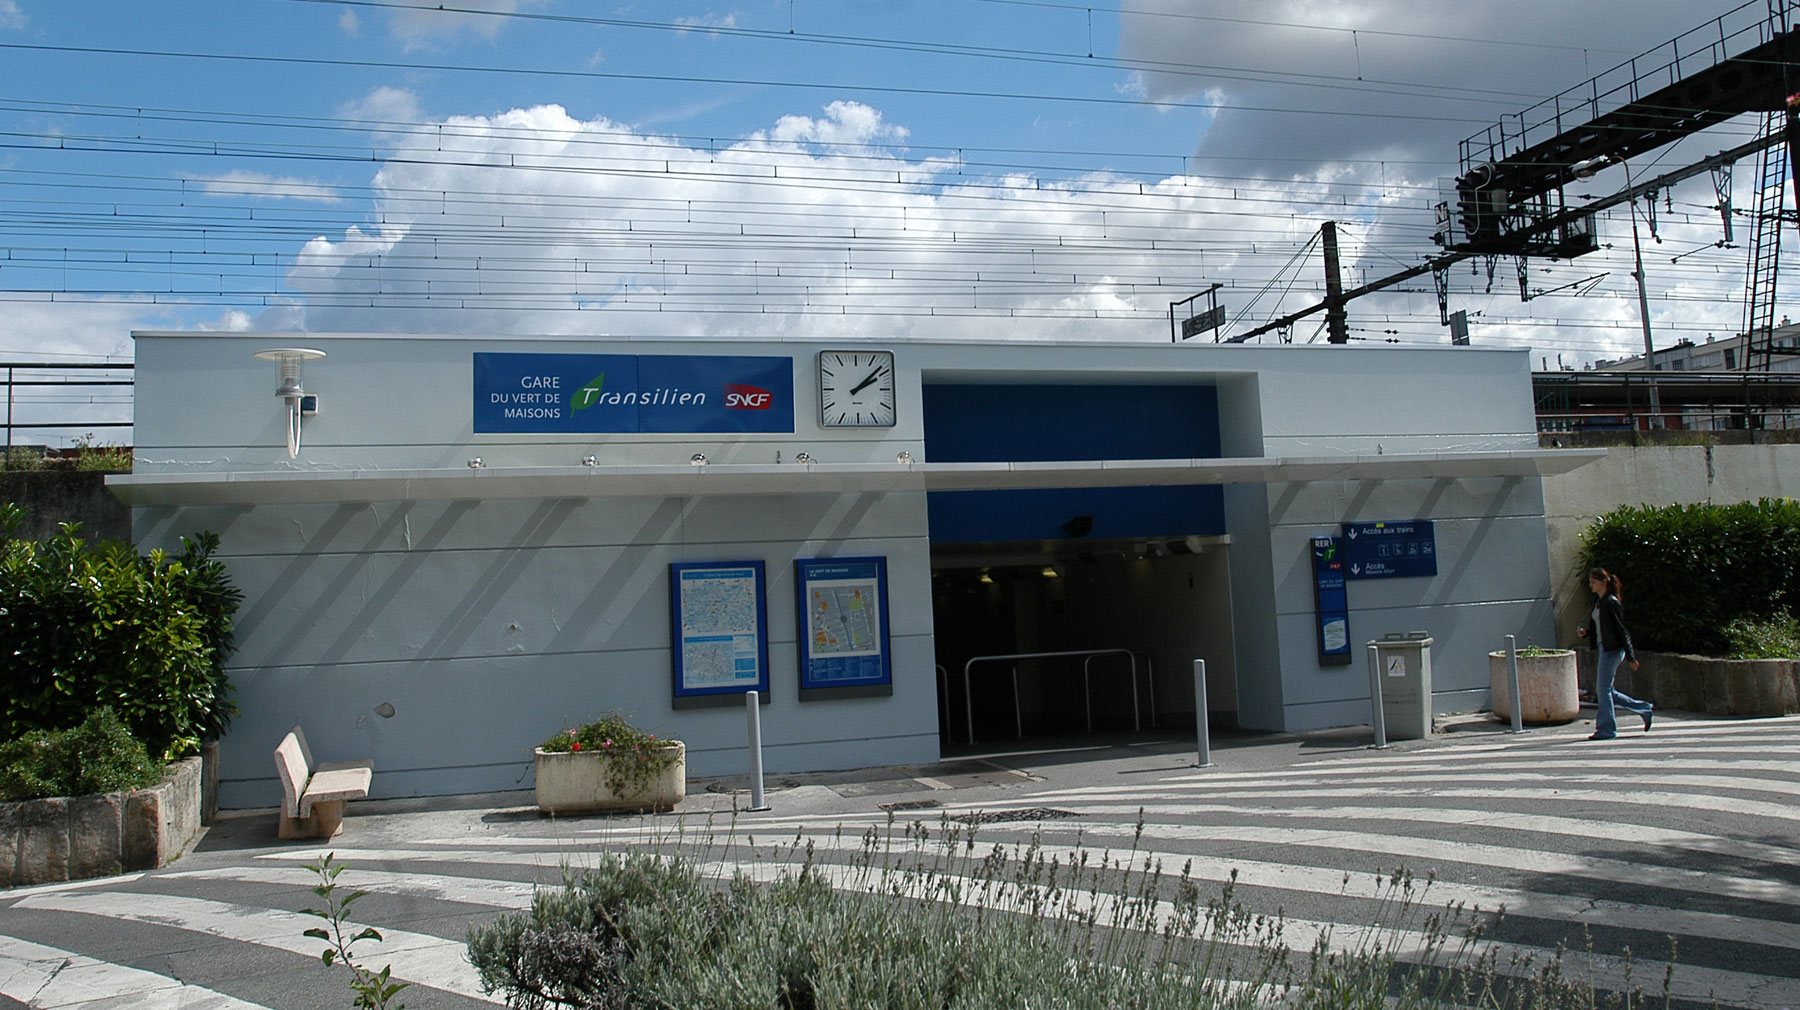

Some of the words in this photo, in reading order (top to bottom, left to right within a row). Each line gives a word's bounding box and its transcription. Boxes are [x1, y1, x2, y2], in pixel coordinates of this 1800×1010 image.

[521, 376, 560, 389] GARE
[491, 393, 509, 404] DU
[512, 393, 541, 404] VERT
[545, 393, 560, 404] DE
[582, 387, 706, 406] Transilien
[725, 393, 770, 407] SNCF
[504, 408, 560, 419] MAISONS
[1315, 540, 1330, 548] RER
